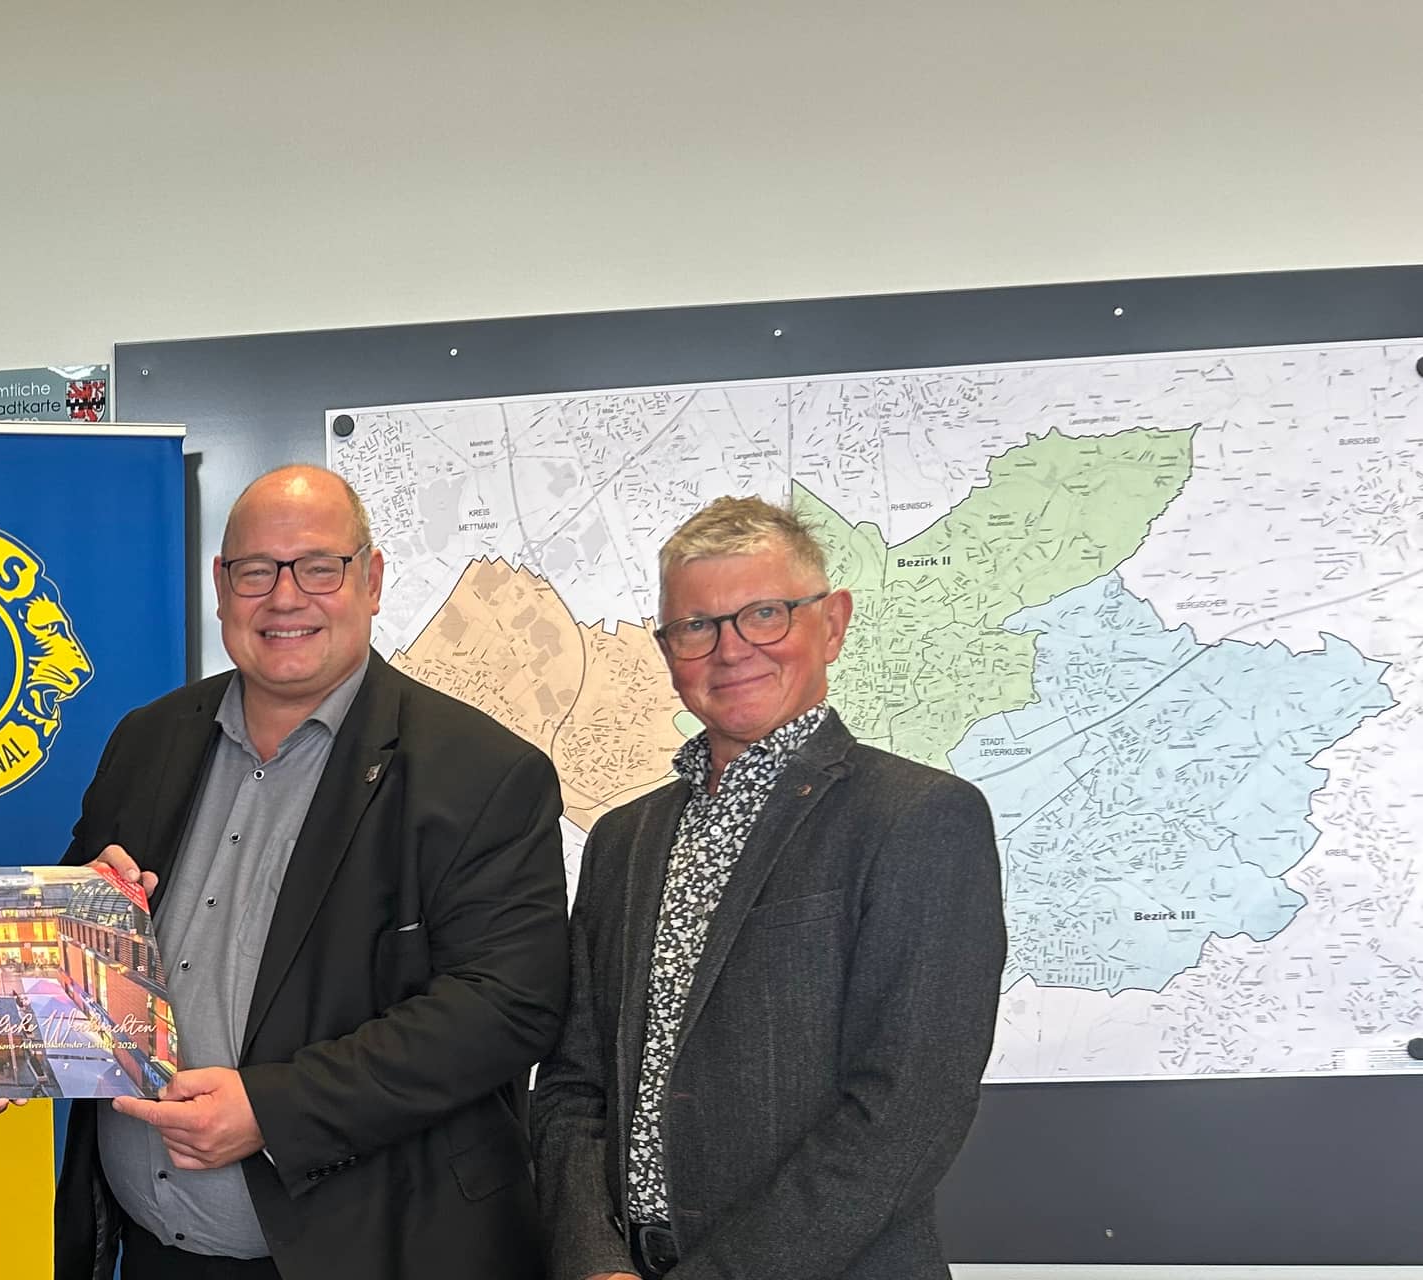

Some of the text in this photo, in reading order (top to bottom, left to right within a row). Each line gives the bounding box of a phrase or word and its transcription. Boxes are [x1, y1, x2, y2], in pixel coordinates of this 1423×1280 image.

[468, 508, 490, 517] KREIS
[458, 522, 498, 532] METTMANN
[897, 556, 951, 568] Bezirk II
[979, 737, 1005, 746] STADT
[979, 747, 1032, 757] LEVERKUSEN
[1134, 910, 1196, 921] Bezirk III
